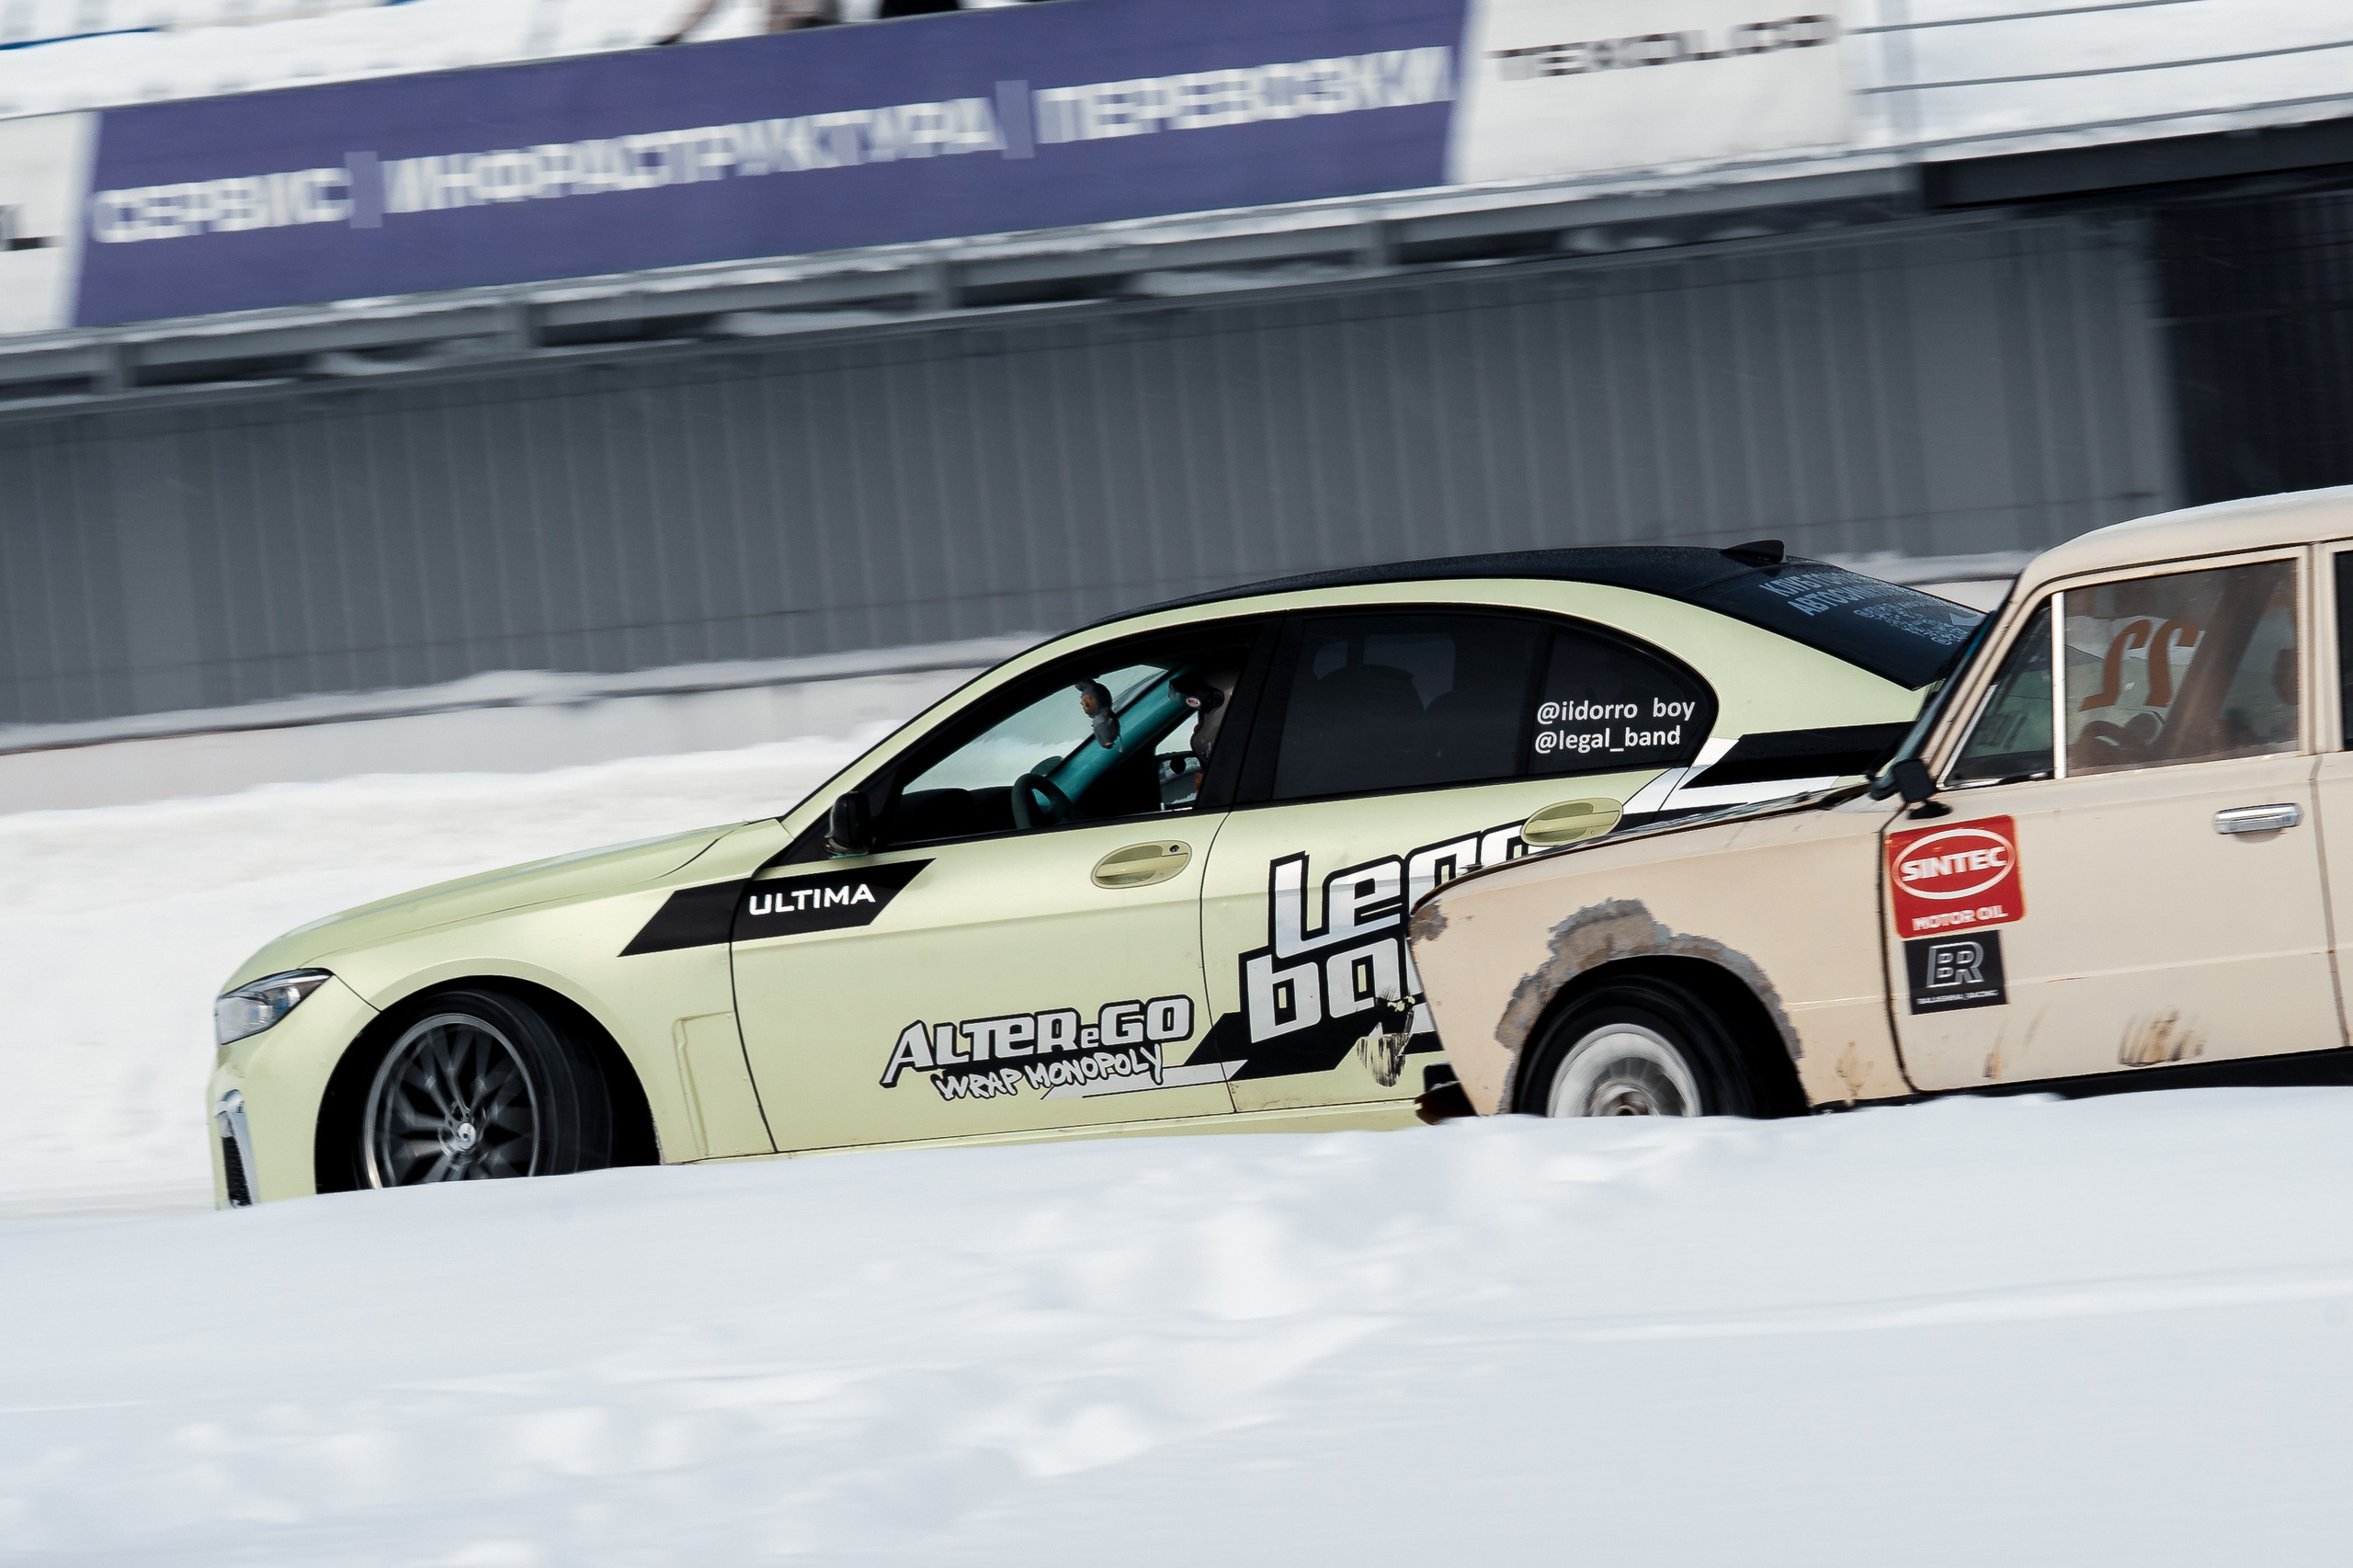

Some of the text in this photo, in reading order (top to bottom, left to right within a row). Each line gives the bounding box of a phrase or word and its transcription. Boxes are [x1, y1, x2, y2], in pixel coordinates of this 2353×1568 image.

[94, 46, 1452, 244] СЕРВИС ИНФРАСТРУКТУРА ПЕРЕВОЗКИ
[1535, 725, 1680, 754] @legal_band
[1901, 846, 2006, 882] SINTEC
[749, 883, 876, 915] ULTIMA
[1913, 905, 2008, 931] MOTOR OIL
[931, 1042, 1165, 1101] WRAP MONOPOLY
